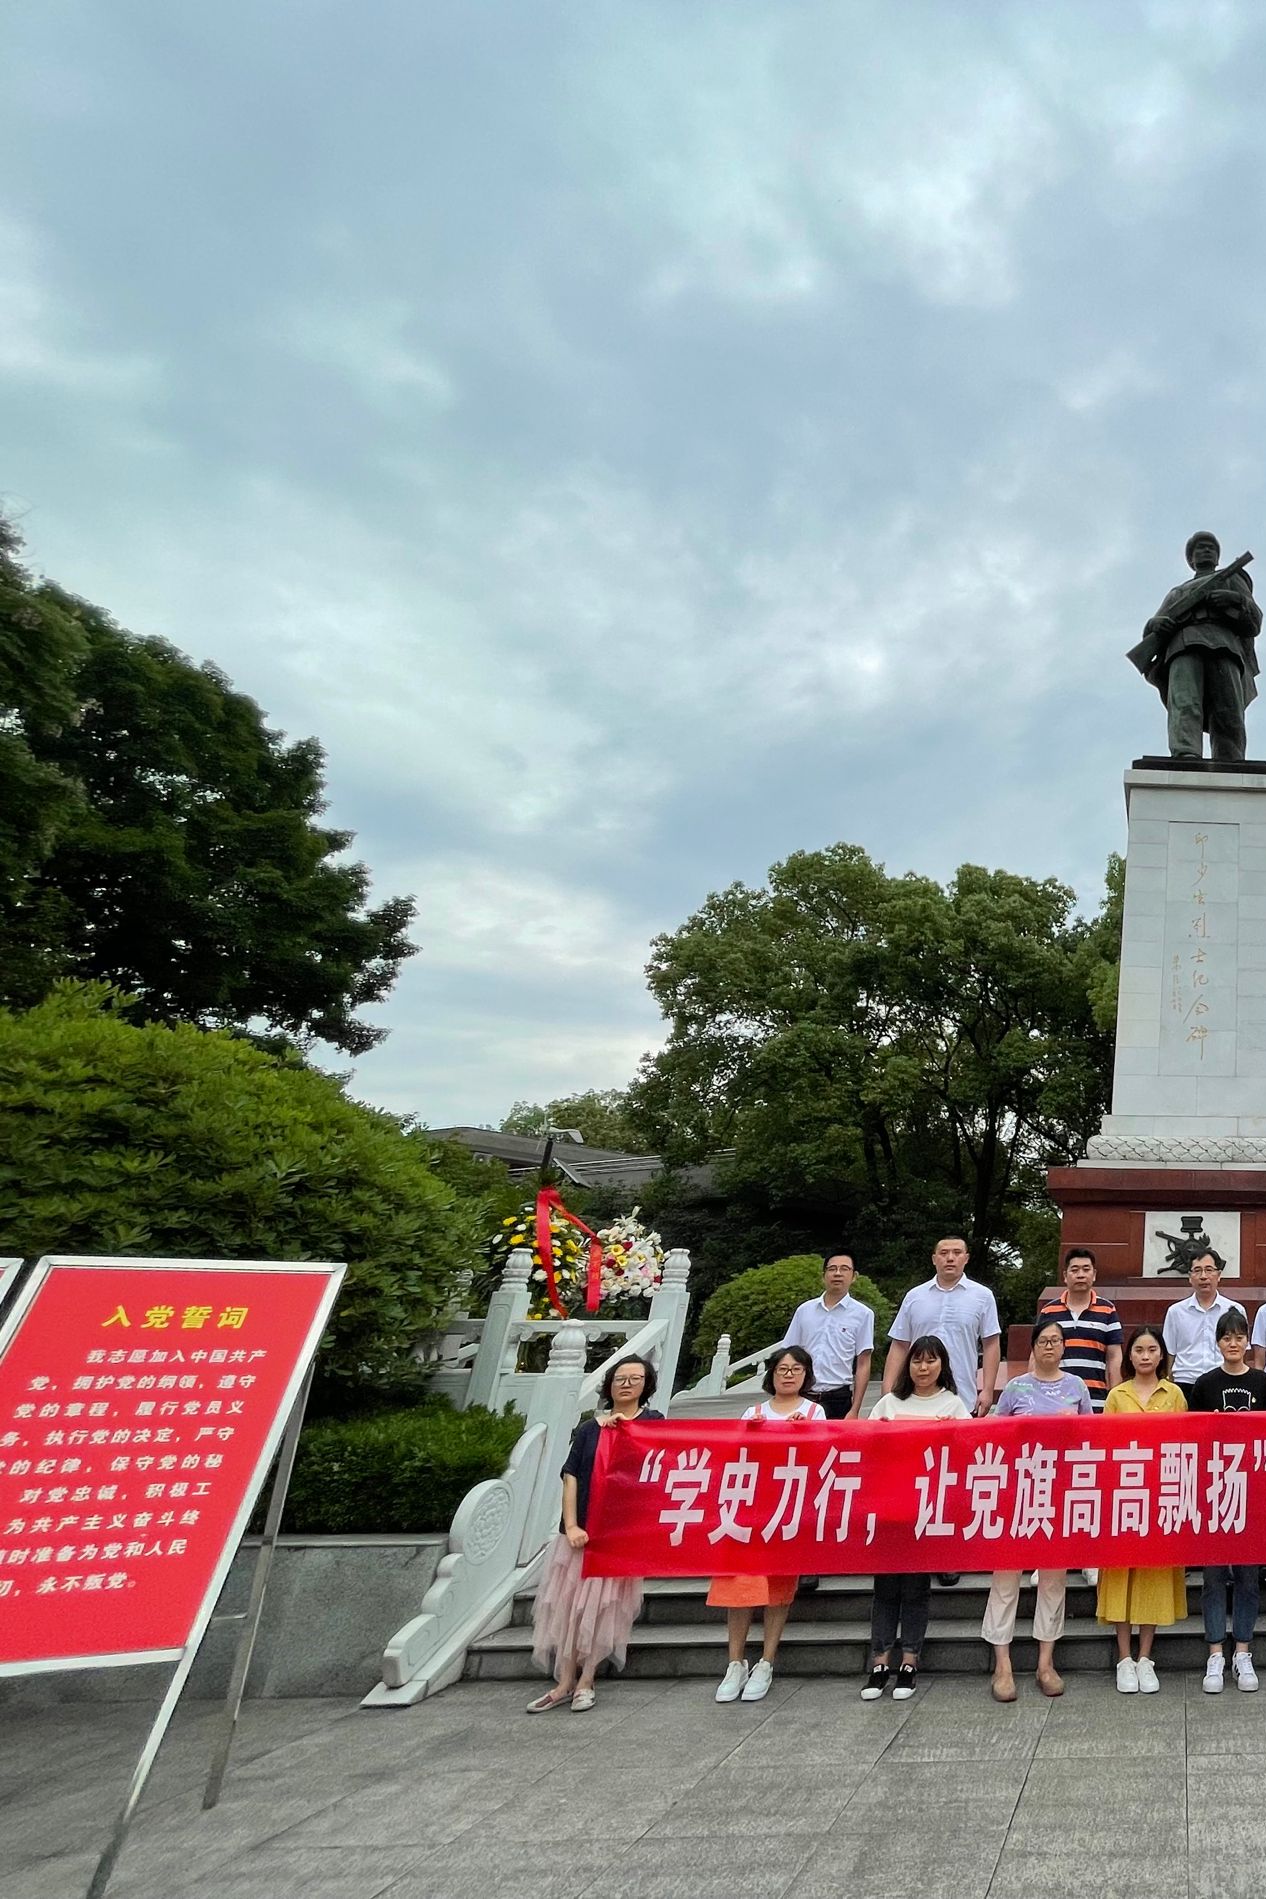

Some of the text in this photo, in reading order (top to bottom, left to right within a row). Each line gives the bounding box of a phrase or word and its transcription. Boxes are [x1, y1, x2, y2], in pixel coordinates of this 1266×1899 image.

[102, 1305, 248, 1328] 入党誓词
[87, 1349, 267, 1363] 我志愿加入中国共产
